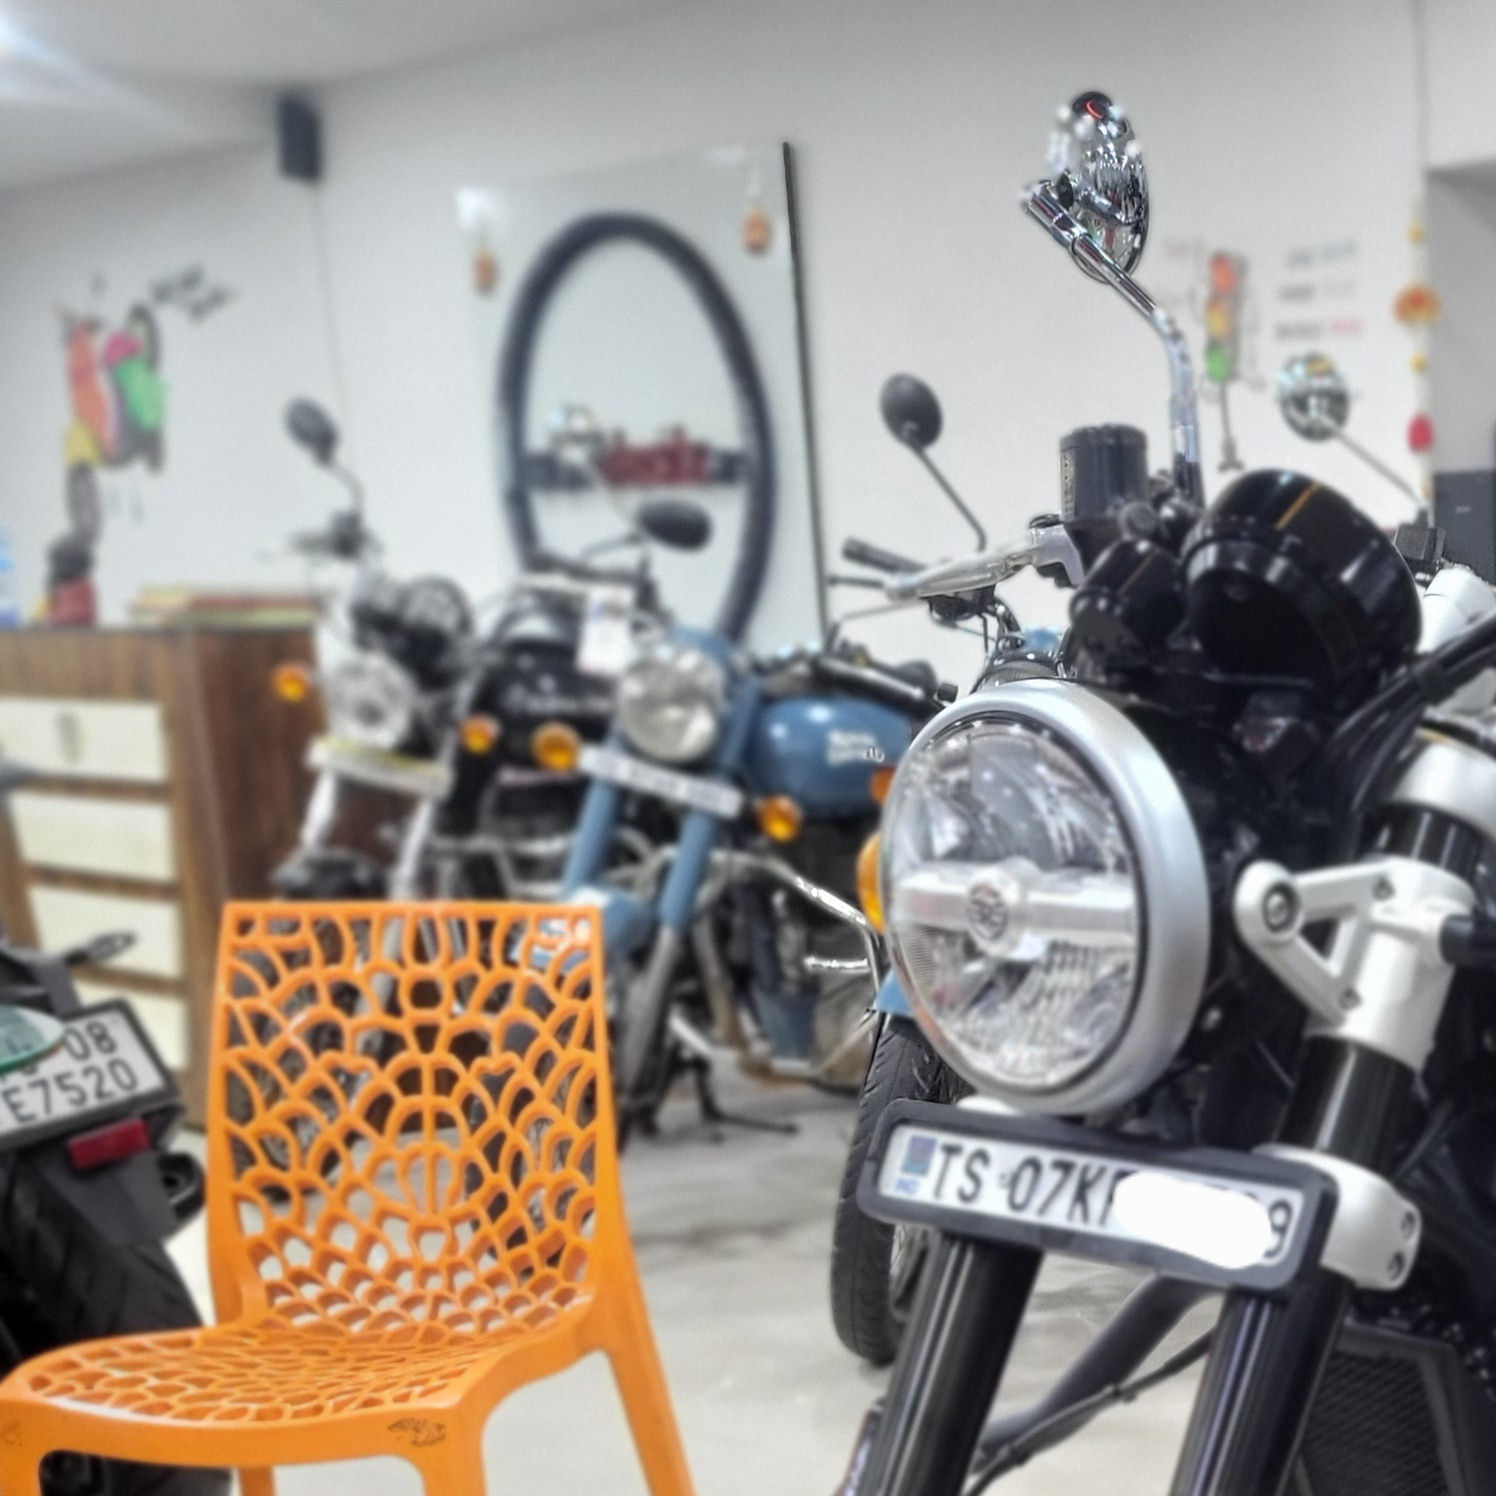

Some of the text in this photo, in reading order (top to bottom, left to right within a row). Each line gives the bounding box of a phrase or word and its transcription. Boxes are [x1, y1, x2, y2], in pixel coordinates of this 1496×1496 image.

[64, 1021, 116, 1060] 08
[2, 1058, 138, 1123] E7520
[932, 1143, 990, 1202] TS
